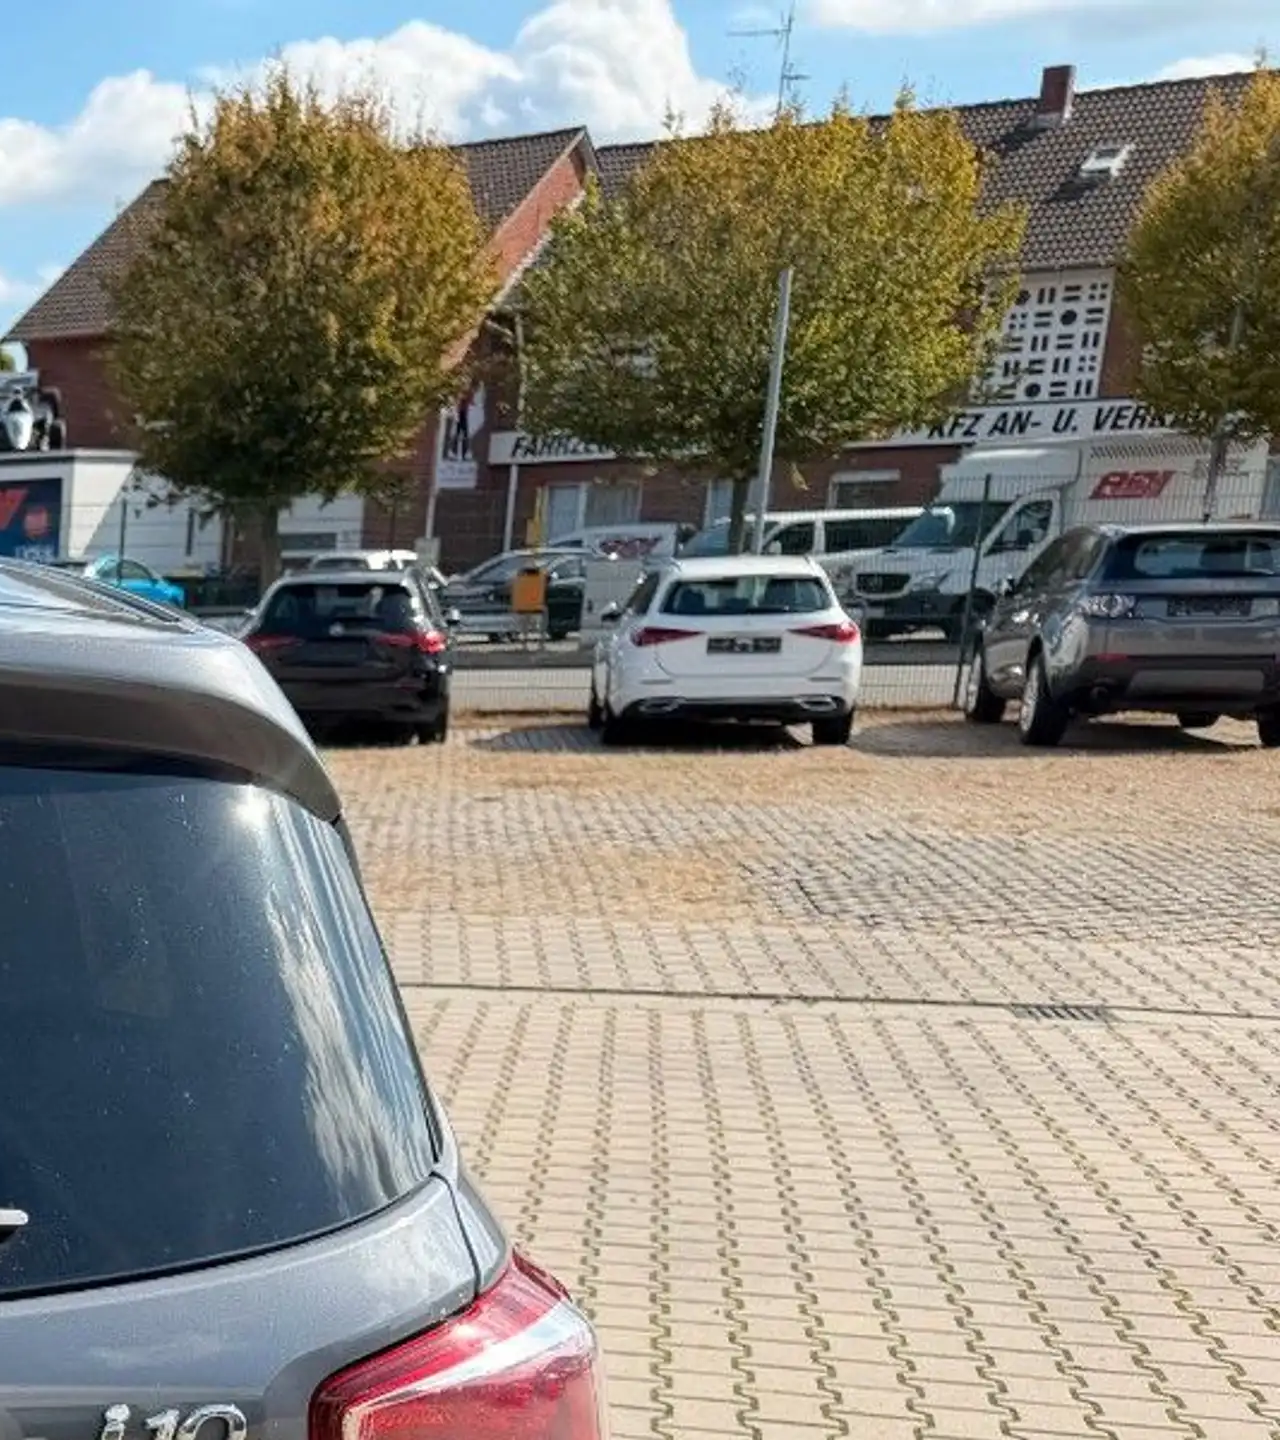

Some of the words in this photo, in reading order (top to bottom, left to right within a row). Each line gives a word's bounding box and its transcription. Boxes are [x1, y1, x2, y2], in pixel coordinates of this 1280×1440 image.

[927, 412, 984, 439] KFZ
[988, 411, 1041, 437] AN-
[1052, 407, 1077, 433] U.
